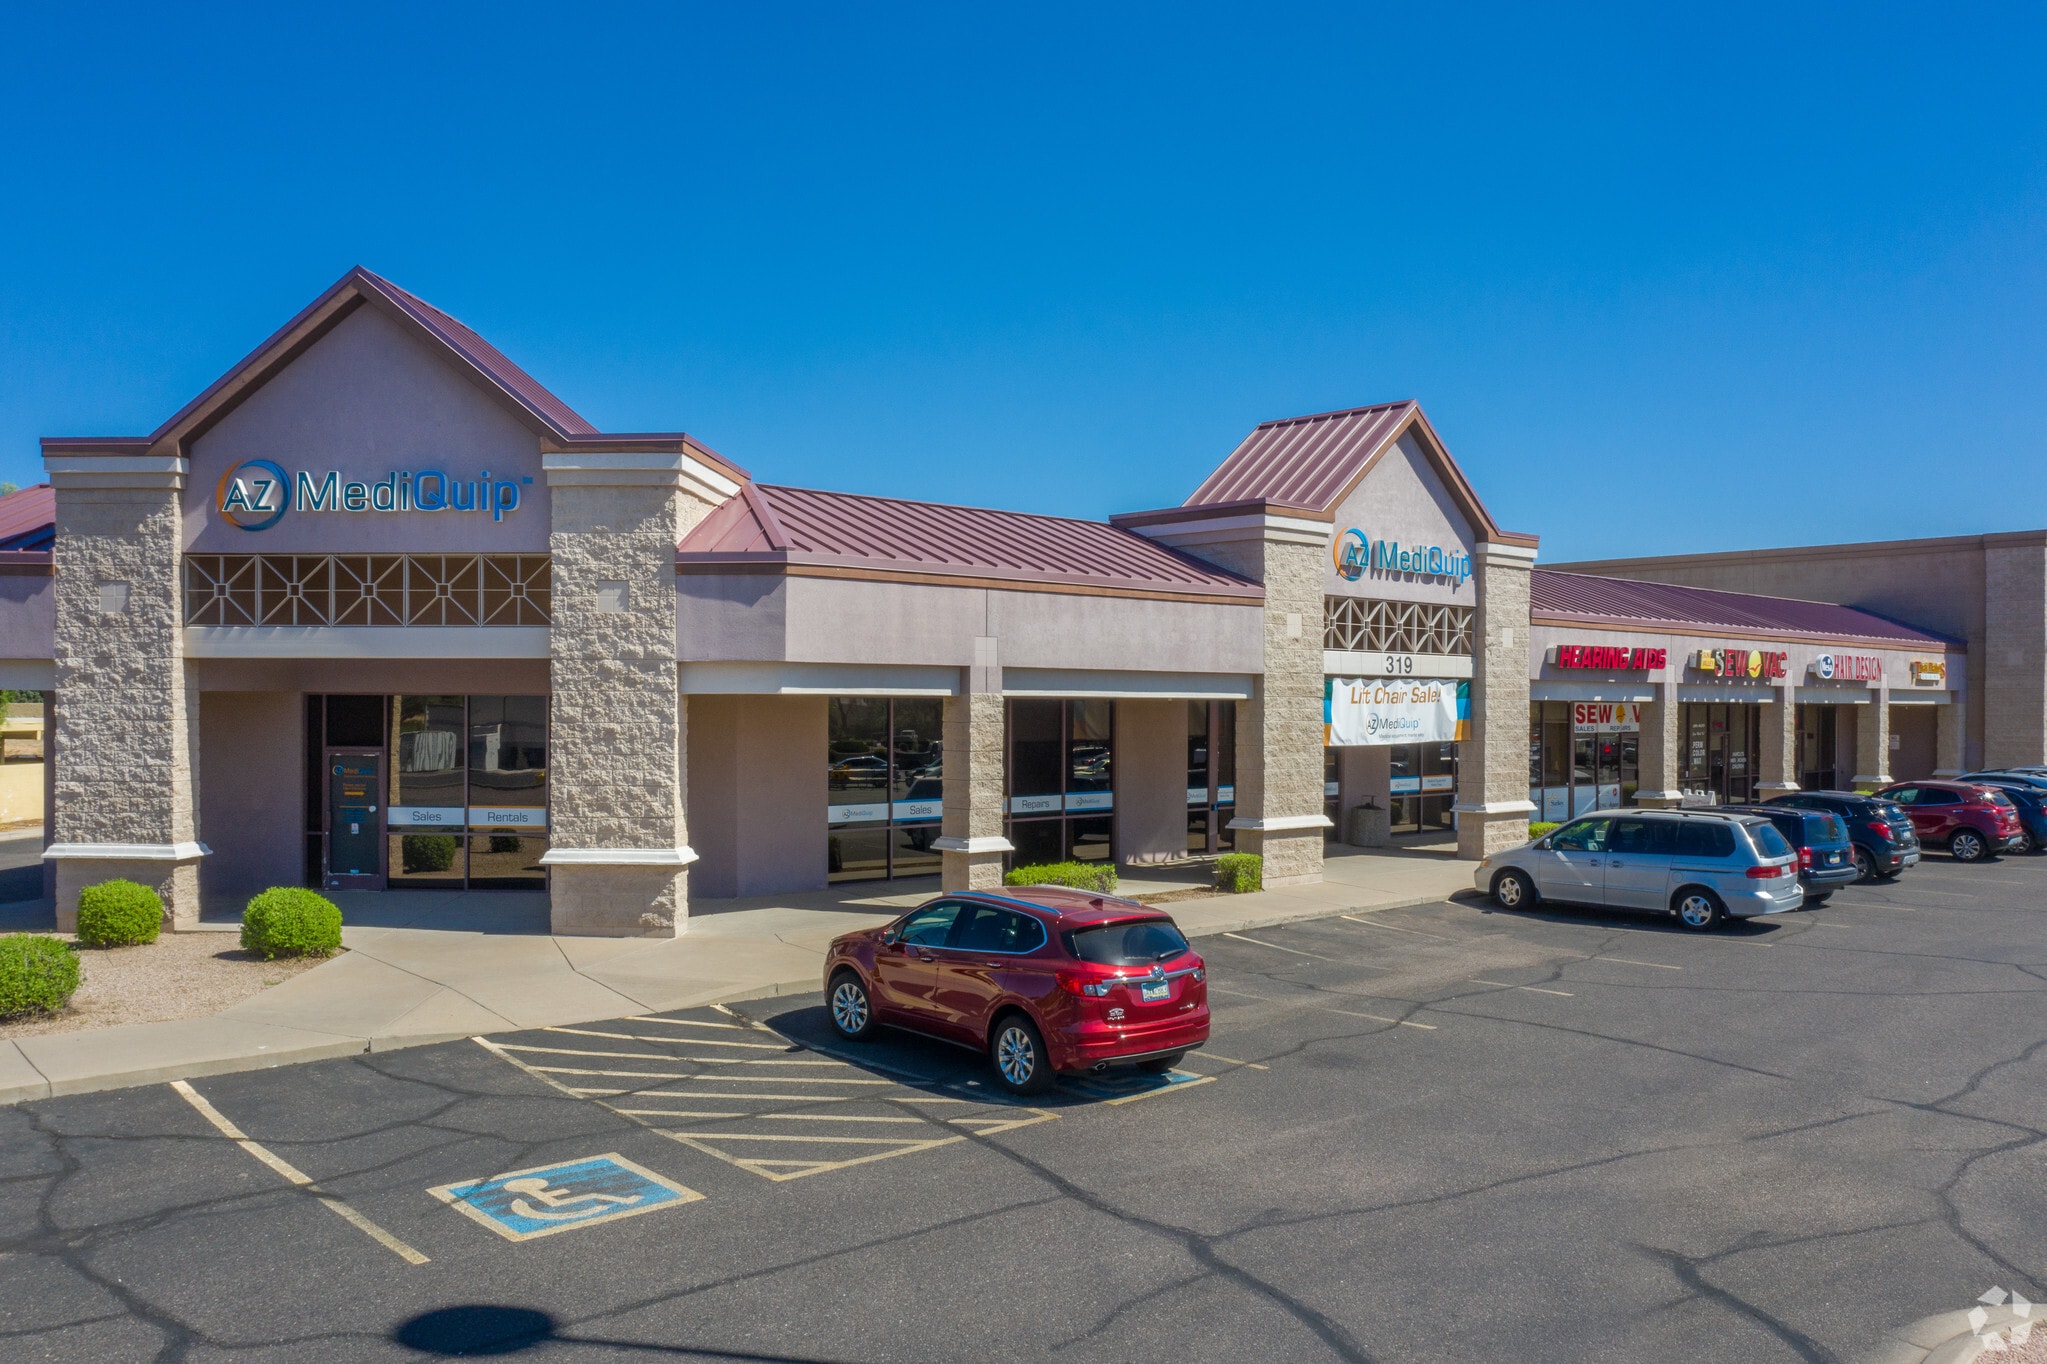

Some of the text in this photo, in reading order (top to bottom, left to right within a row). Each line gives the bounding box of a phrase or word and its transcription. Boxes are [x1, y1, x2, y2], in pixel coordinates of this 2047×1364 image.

[223, 470, 520, 523] AZ MediQuip
[1378, 540, 1472, 584] MediQuip
[1386, 656, 1413, 674] 319
[1559, 645, 1667, 669] HEARING AIDS
[1714, 648, 1788, 679] SEW VAC
[1834, 655, 1852, 679] HAIR
[1856, 656, 1882, 681] DESIGN
[1351, 686, 1441, 704] Lift Chair Sale!
[1575, 704, 1612, 724] SEW
[1379, 718, 1419, 730] MediQuip
[909, 804, 932, 815] Sales
[1021, 799, 1050, 810] Repairs
[412, 811, 442, 822] Sales
[487, 812, 529, 822] Rentals
